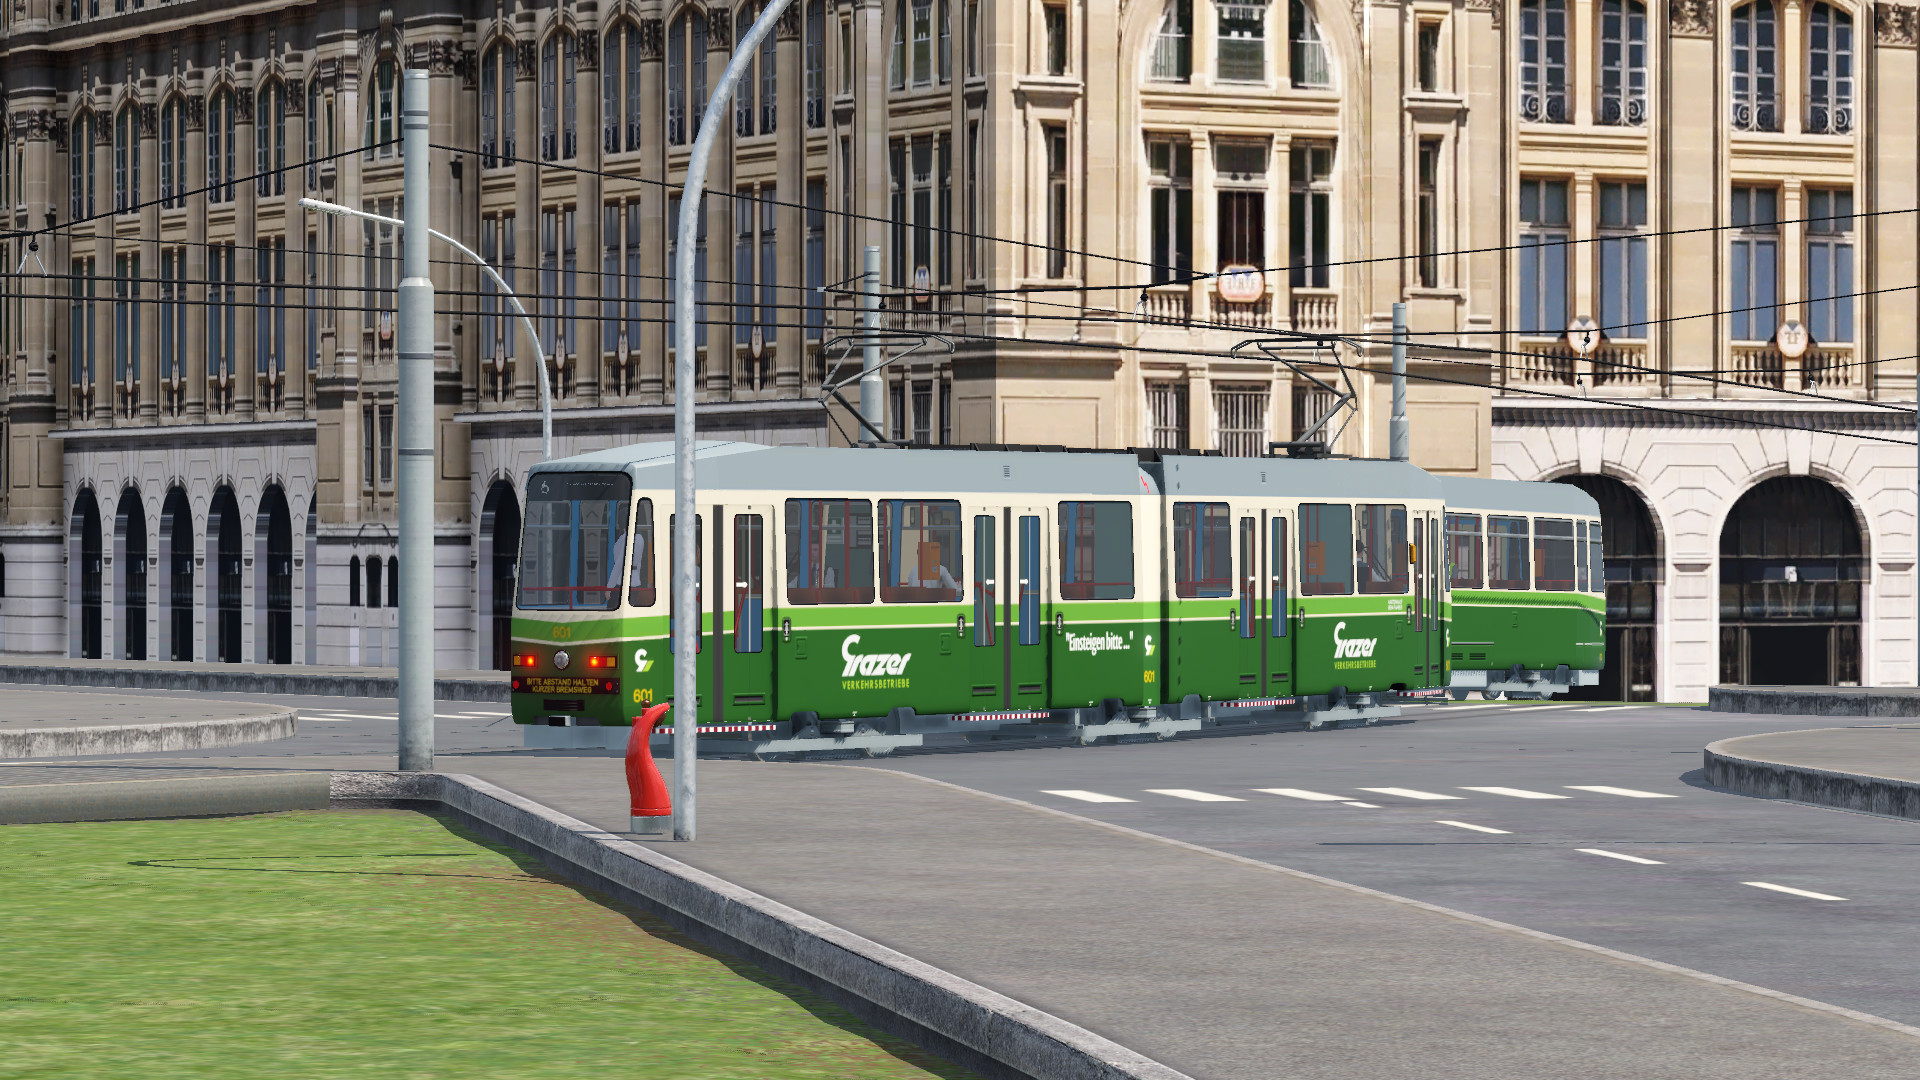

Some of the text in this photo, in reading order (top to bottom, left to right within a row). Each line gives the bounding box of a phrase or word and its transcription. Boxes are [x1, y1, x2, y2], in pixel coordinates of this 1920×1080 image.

[553, 626, 571, 639] 601
[1333, 621, 1378, 659] Grazer
[841, 633, 912, 677] Grazer
[1333, 660, 1377, 670] VERKEHRSBETRIEBE
[526, 677, 599, 687] BITTE ABSTAND HALTEN
[1143, 670, 1155, 683] 601
[532, 685, 593, 694] KURZER BREMSWEG
[841, 679, 910, 690] VERKEHRSBETRIEBE
[633, 688, 653, 703] 601
